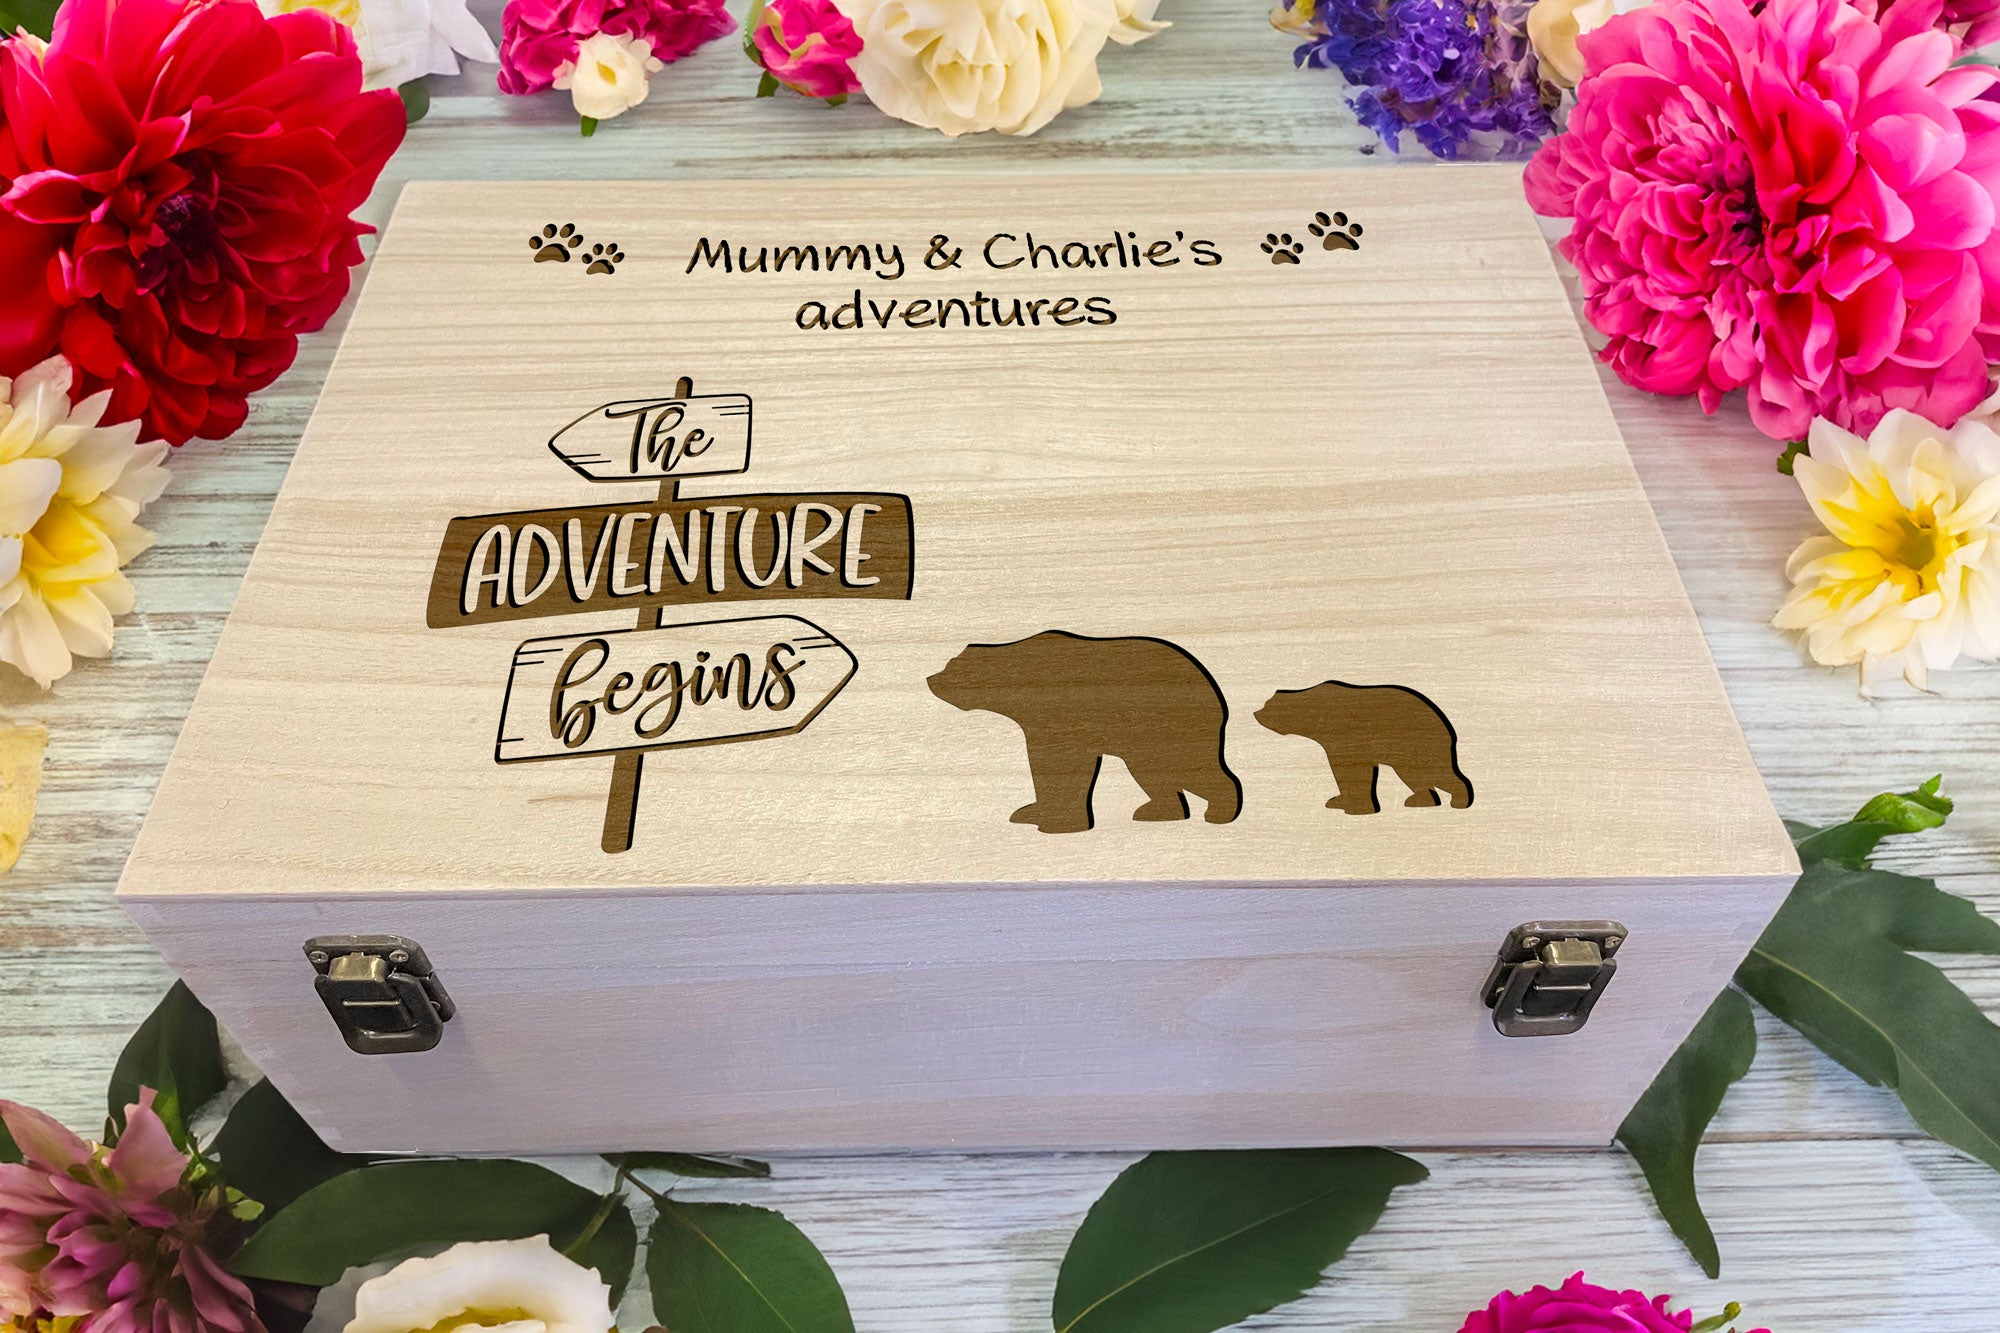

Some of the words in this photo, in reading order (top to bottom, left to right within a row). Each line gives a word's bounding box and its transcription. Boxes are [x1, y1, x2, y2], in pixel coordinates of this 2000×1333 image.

[685, 236, 906, 280] Mummy
[923, 233, 963, 270] &
[983, 230, 1223, 270] Charlie's
[795, 288, 1118, 330] adventures
[606, 402, 714, 474] The
[460, 502, 882, 615] ADVENTURE
[549, 638, 806, 748] begins
